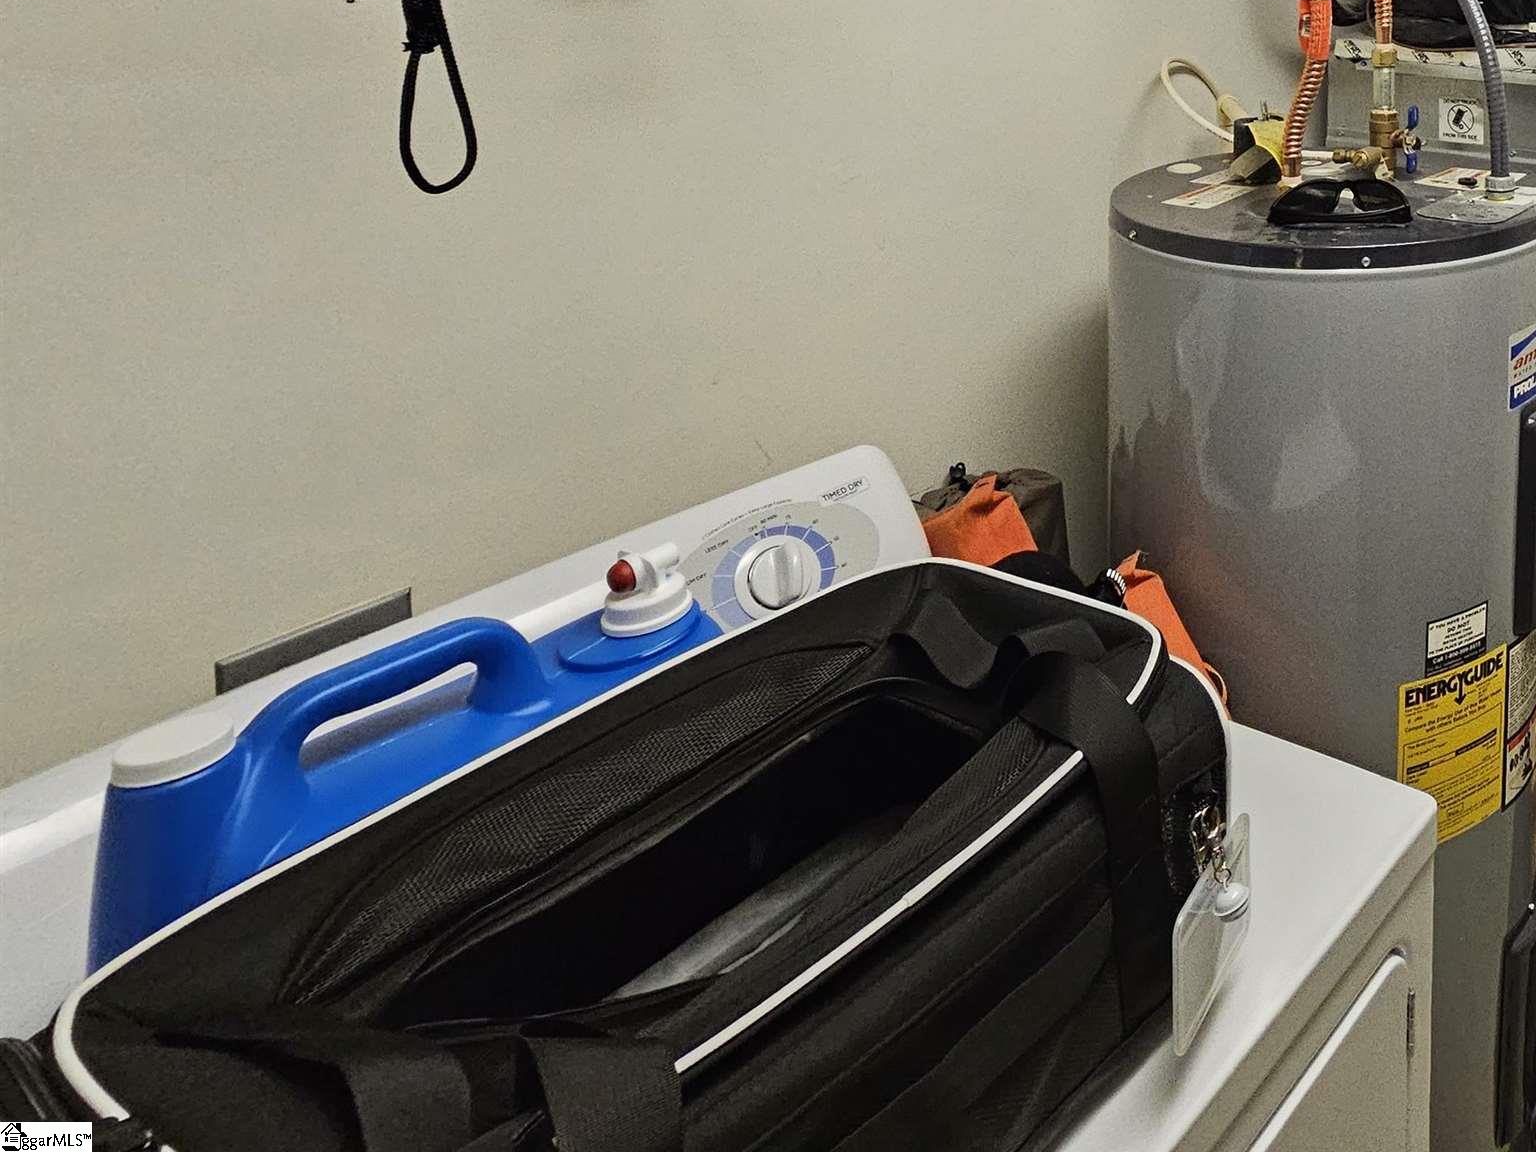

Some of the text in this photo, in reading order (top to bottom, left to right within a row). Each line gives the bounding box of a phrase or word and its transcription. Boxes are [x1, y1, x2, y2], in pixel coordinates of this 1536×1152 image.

[822, 485, 847, 501] TIMED
[847, 479, 864, 492] DRY
[1405, 651, 1503, 708] ENERGYGUIDE
